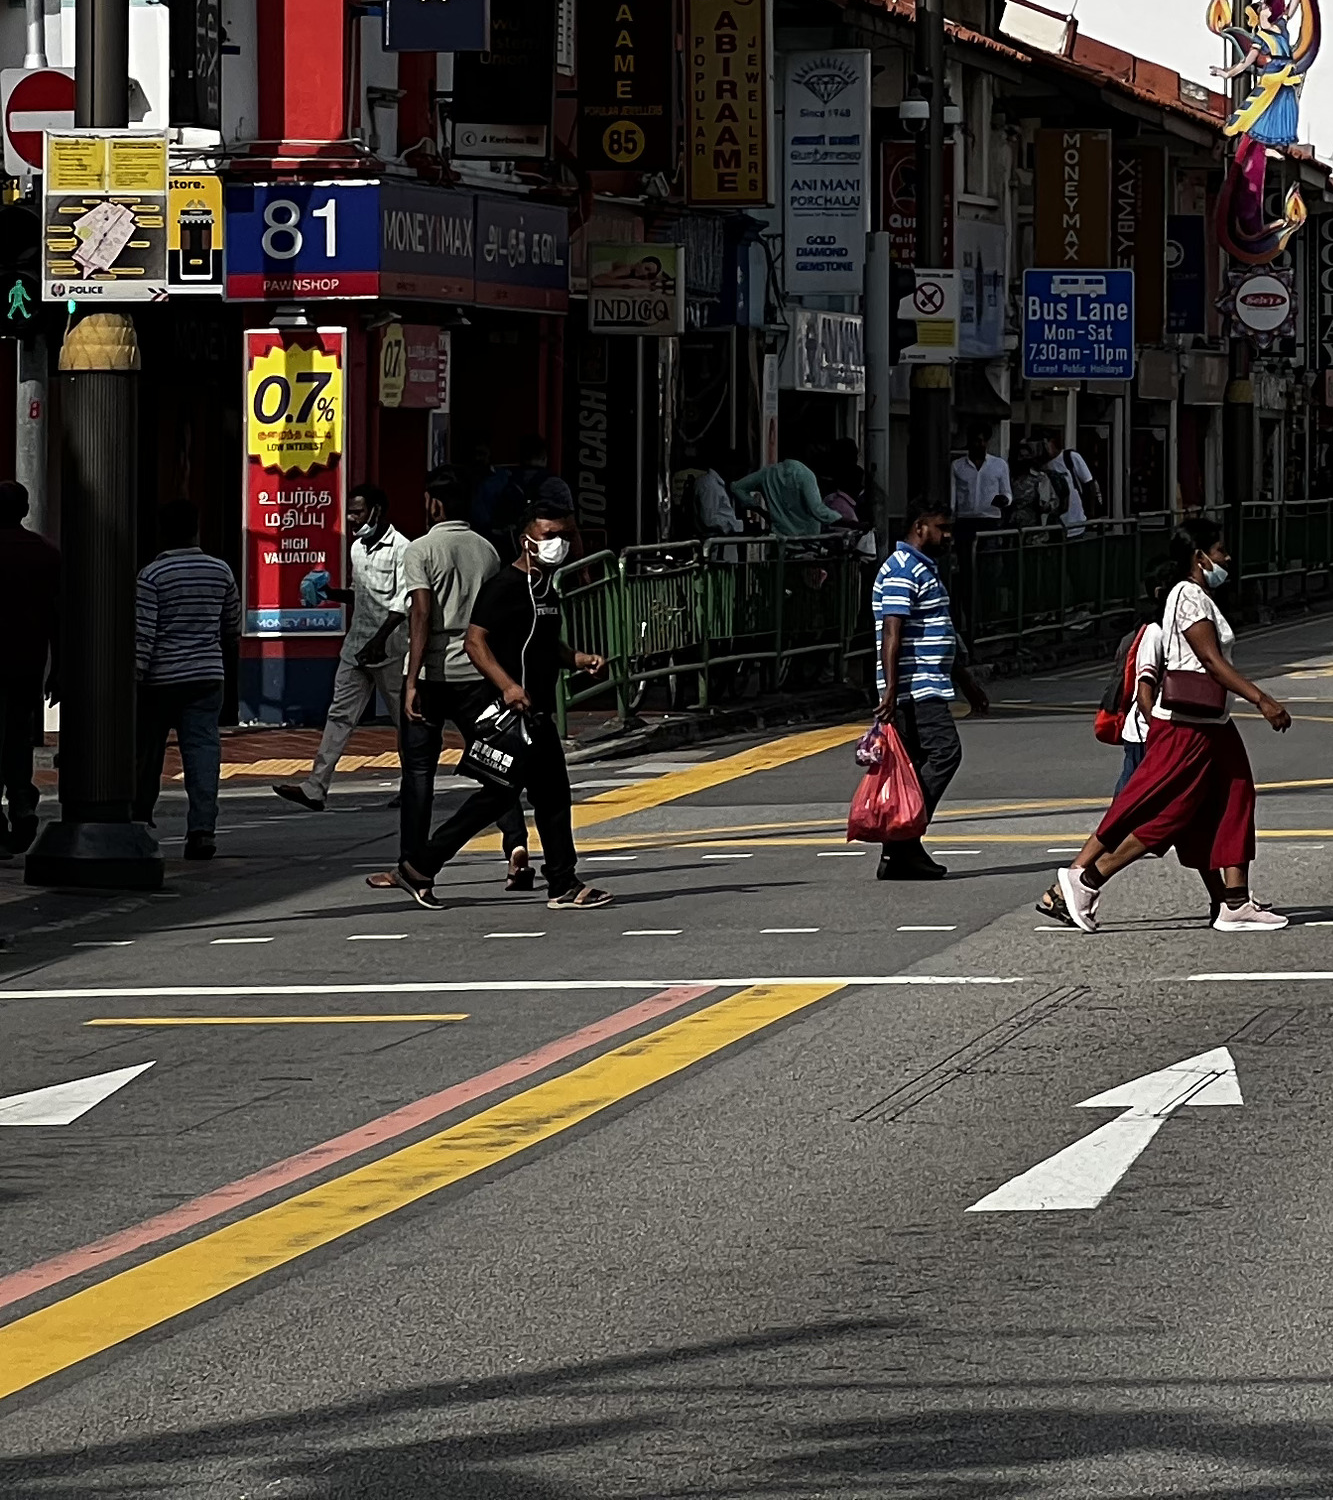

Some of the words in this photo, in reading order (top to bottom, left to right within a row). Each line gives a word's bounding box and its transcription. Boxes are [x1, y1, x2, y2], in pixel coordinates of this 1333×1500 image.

[694, 36, 706, 156] POPULAR
[713, 10, 741, 193] ABIRAAME
[745, 35, 760, 192] JEWELLERS
[608, 129, 638, 155] 85
[790, 178, 819, 191] ANI
[820, 178, 860, 191] MANI
[790, 195, 860, 206] PORCHALAI
[1062, 133, 1082, 261] MONEYMAX
[261, 198, 338, 260] 81
[806, 234, 836, 246] GOLD
[796, 247, 848, 258] DIAMOND
[795, 260, 854, 272] GEMSTONE
[68, 285, 104, 295] POLICE
[262, 278, 340, 292] PAWNSHOP
[1027, 296, 1068, 322] Bus
[1076, 296, 1129, 321] Lane
[1032, 363, 1059, 374] Except
[1062, 363, 1087, 374] Public
[1089, 363, 1124, 376] Holidays
[253, 371, 336, 425] 0.7%
[578, 388, 608, 469] CASH
[267, 443, 284, 452] LOW
[286, 442, 324, 451] INTEREST
[578, 470, 608, 525] TOP
[280, 537, 309, 550] HIGH
[263, 551, 326, 565] VALUATION
